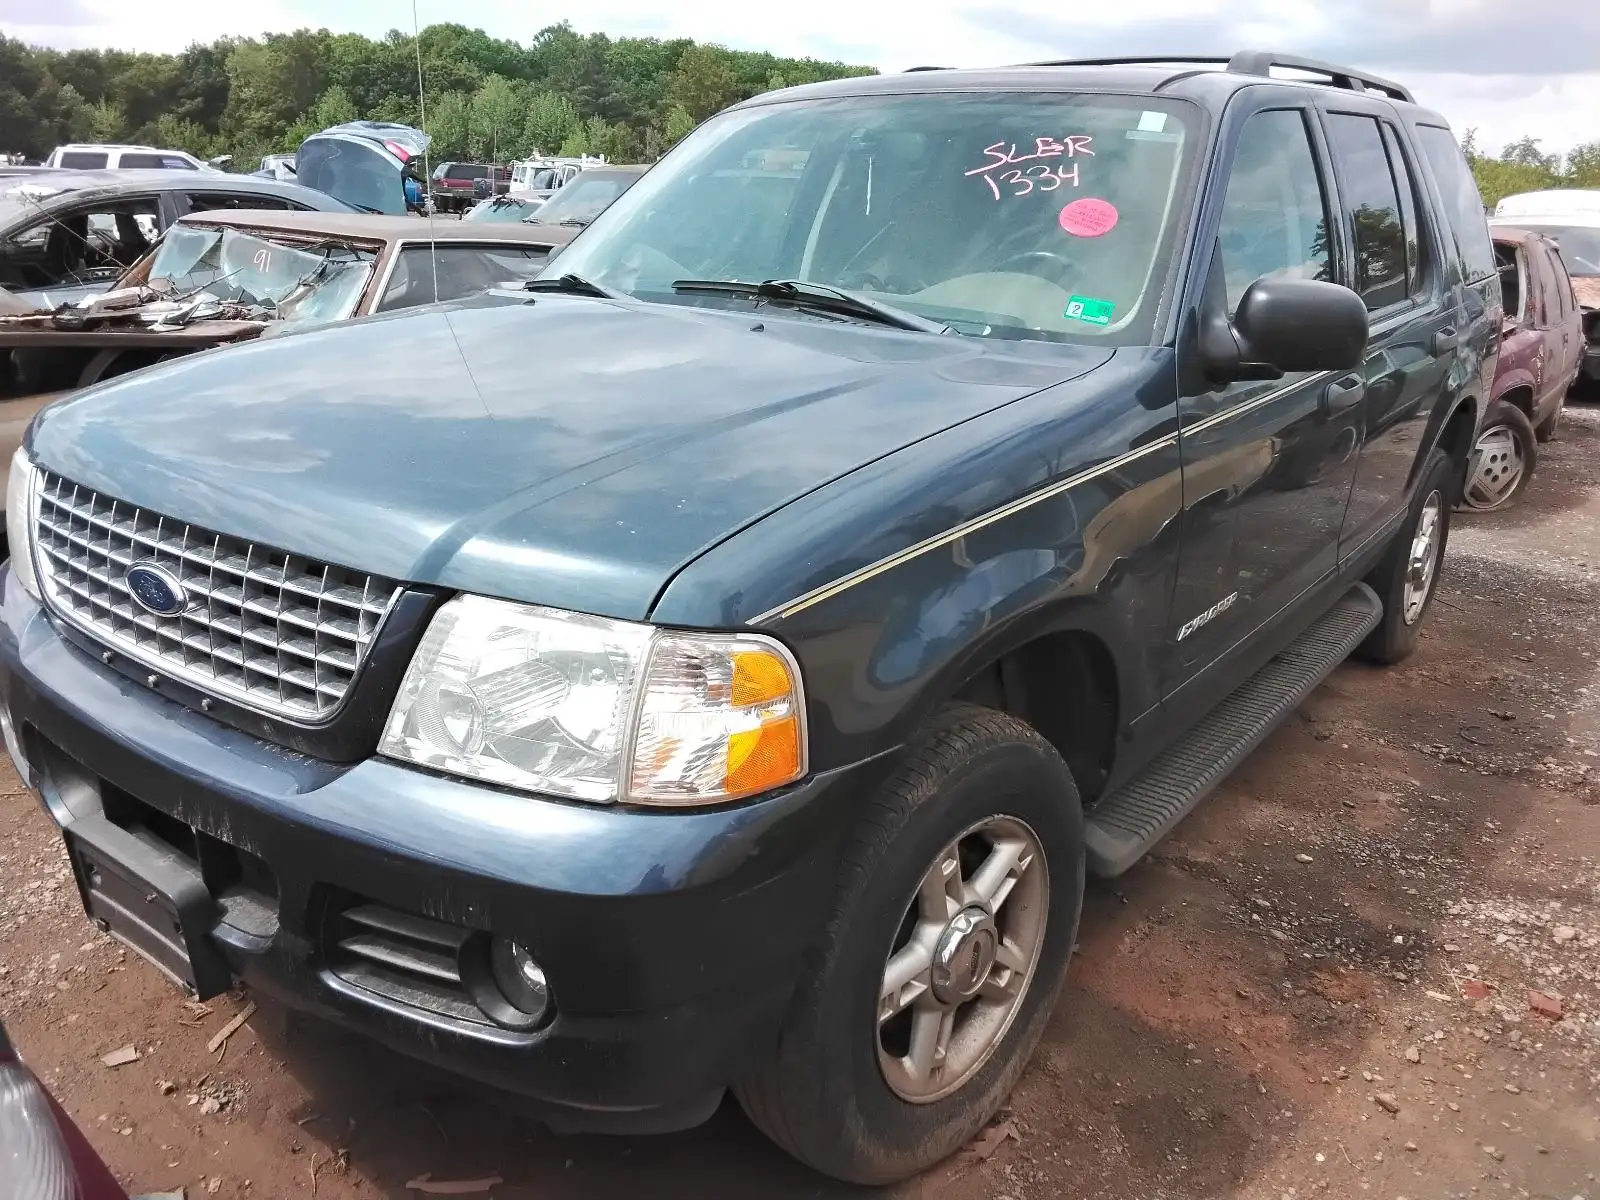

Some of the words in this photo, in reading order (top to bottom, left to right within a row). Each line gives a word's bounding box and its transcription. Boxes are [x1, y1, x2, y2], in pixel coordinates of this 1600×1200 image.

[984, 163, 1079, 201] 1334
[254, 249, 271, 273] 91
[1071, 304, 1081, 315] 2
